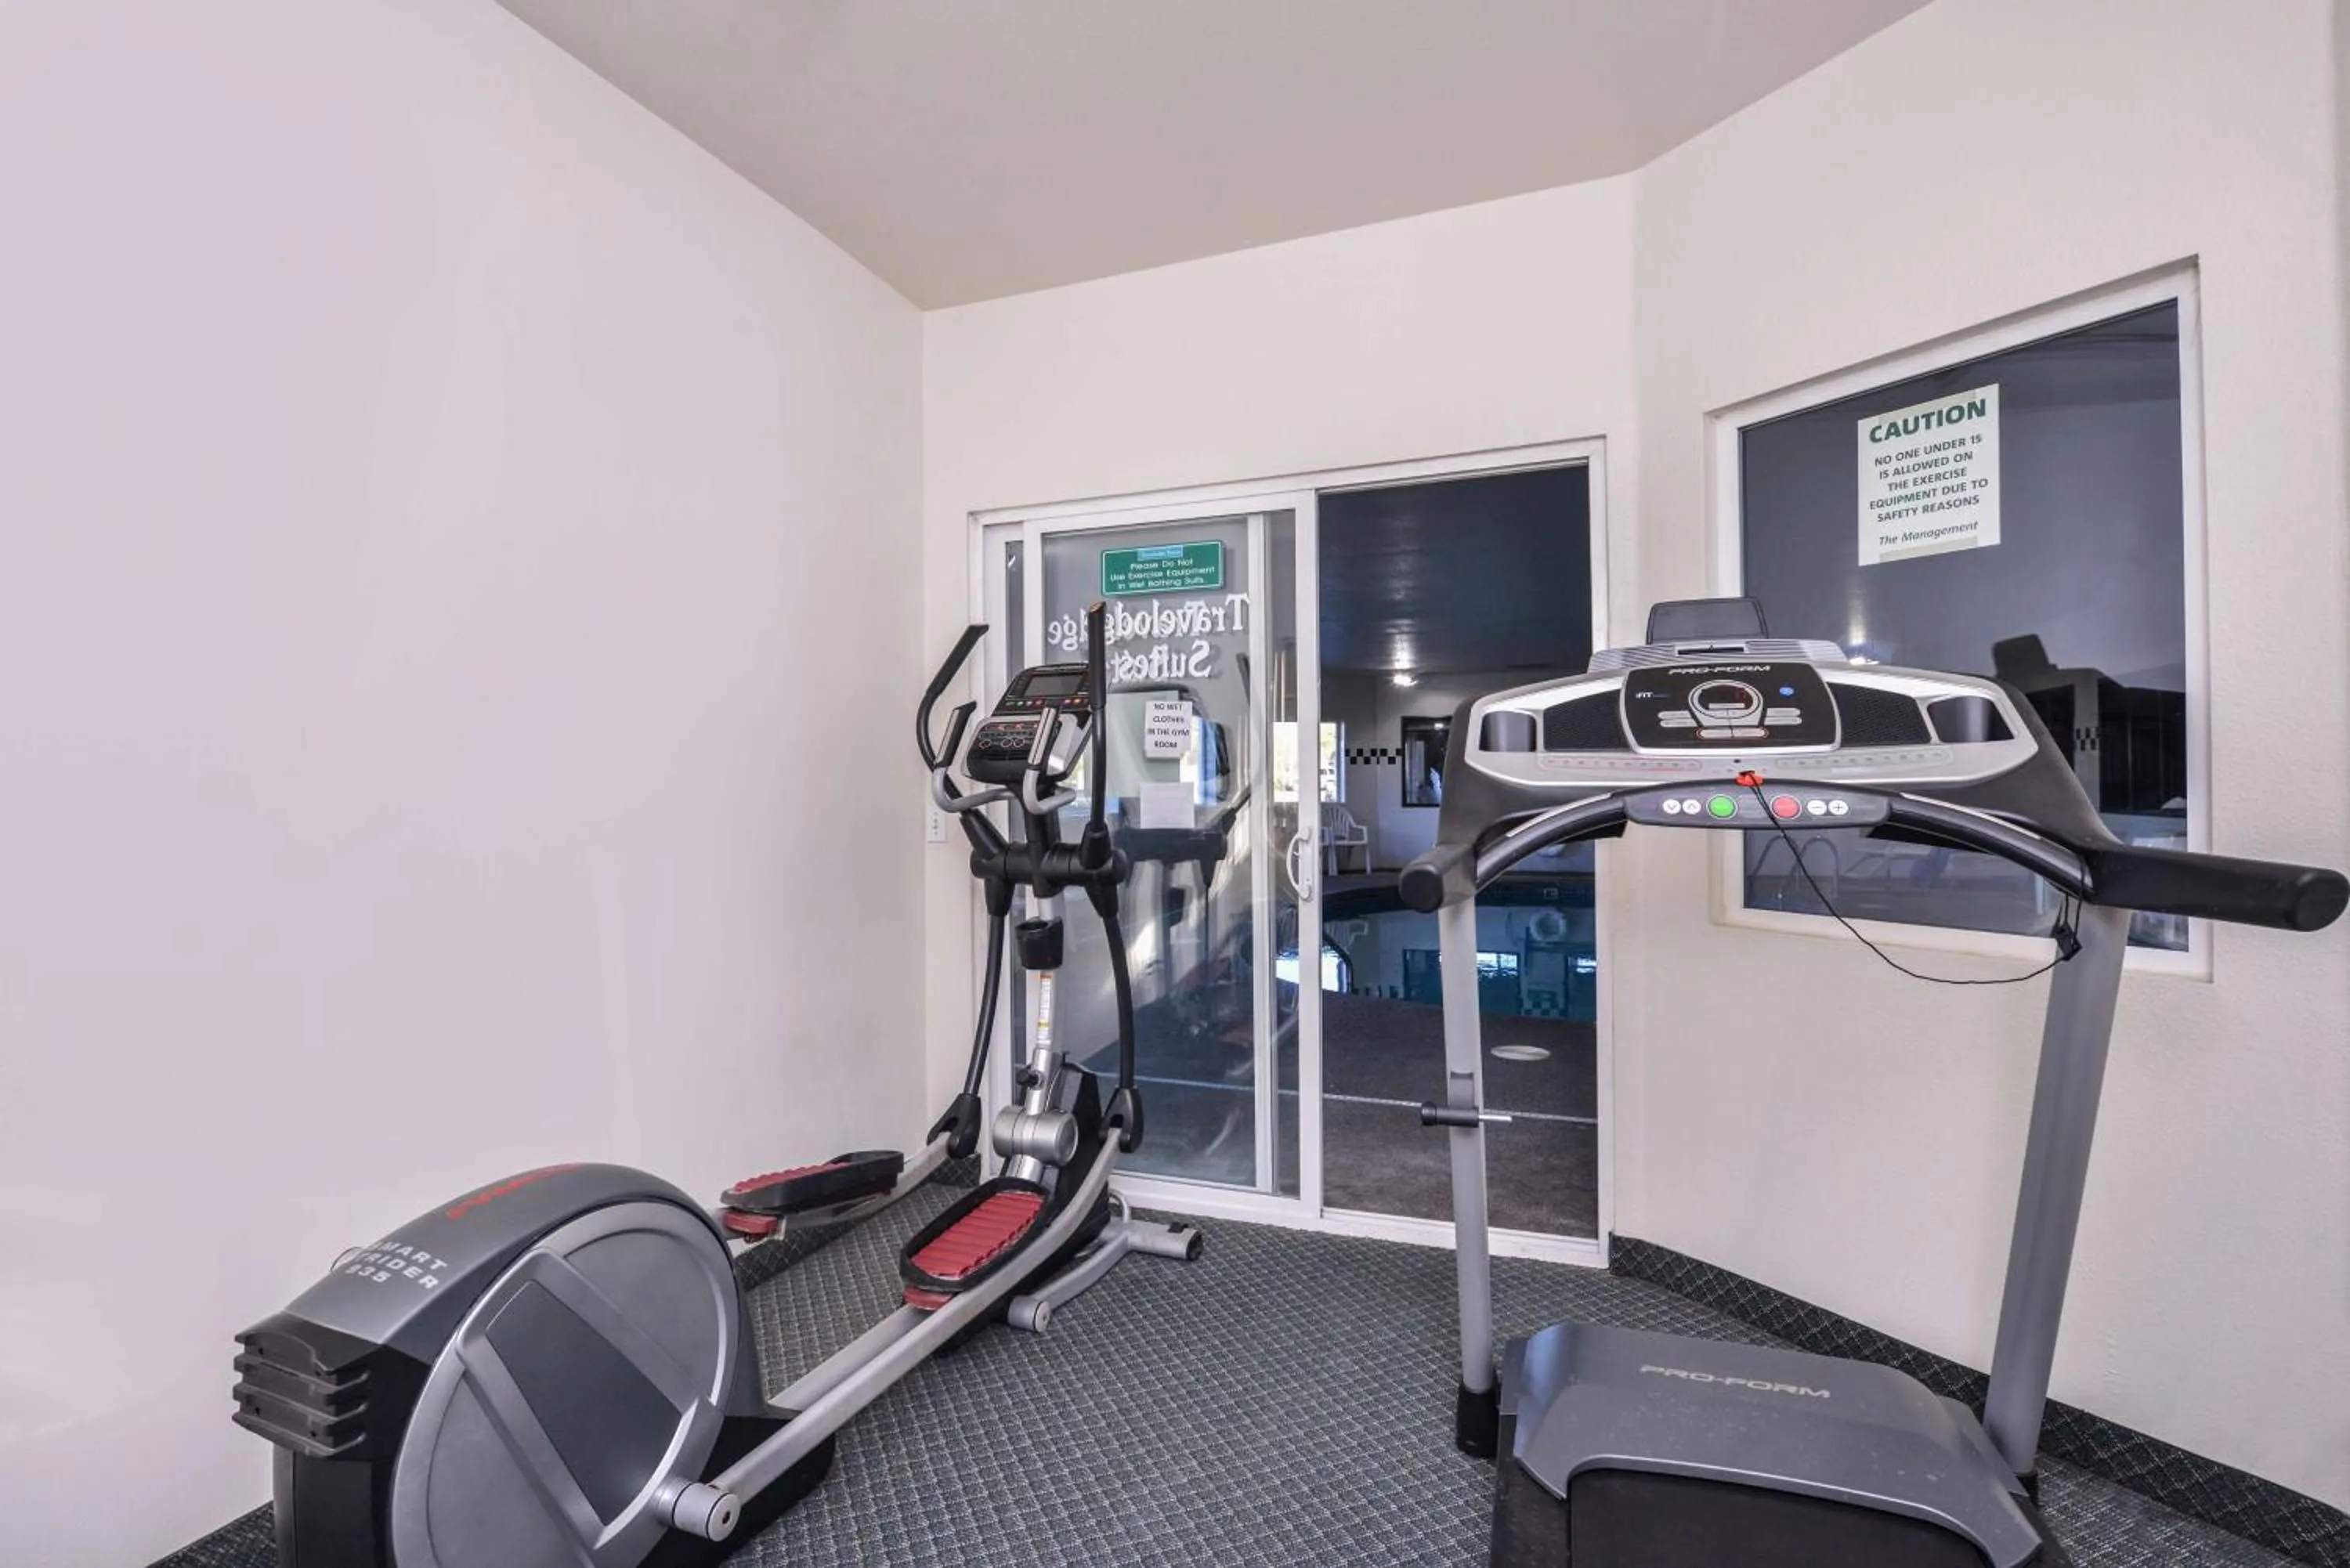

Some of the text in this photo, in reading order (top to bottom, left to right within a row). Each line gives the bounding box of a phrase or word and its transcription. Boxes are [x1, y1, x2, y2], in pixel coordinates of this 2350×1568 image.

[1869, 399, 1986, 443] CAUTION
[1875, 434, 1982, 467] NO ONE UNDER 15
[1880, 451, 1973, 479] IS ALLOWED ON
[1888, 468, 1968, 492] THE EXERCISE
[1870, 478, 1989, 510] EQUIPMENT DUE TO
[1877, 495, 1979, 522] SAFETY REASONS
[1880, 521, 1979, 545] The Management
[1128, 571, 1163, 580] Exercise
[1166, 566, 1215, 578] Equipment
[1668, 664, 1770, 675] PRO-FORM
[1640, 1364, 1831, 1398] PRO-FORM
